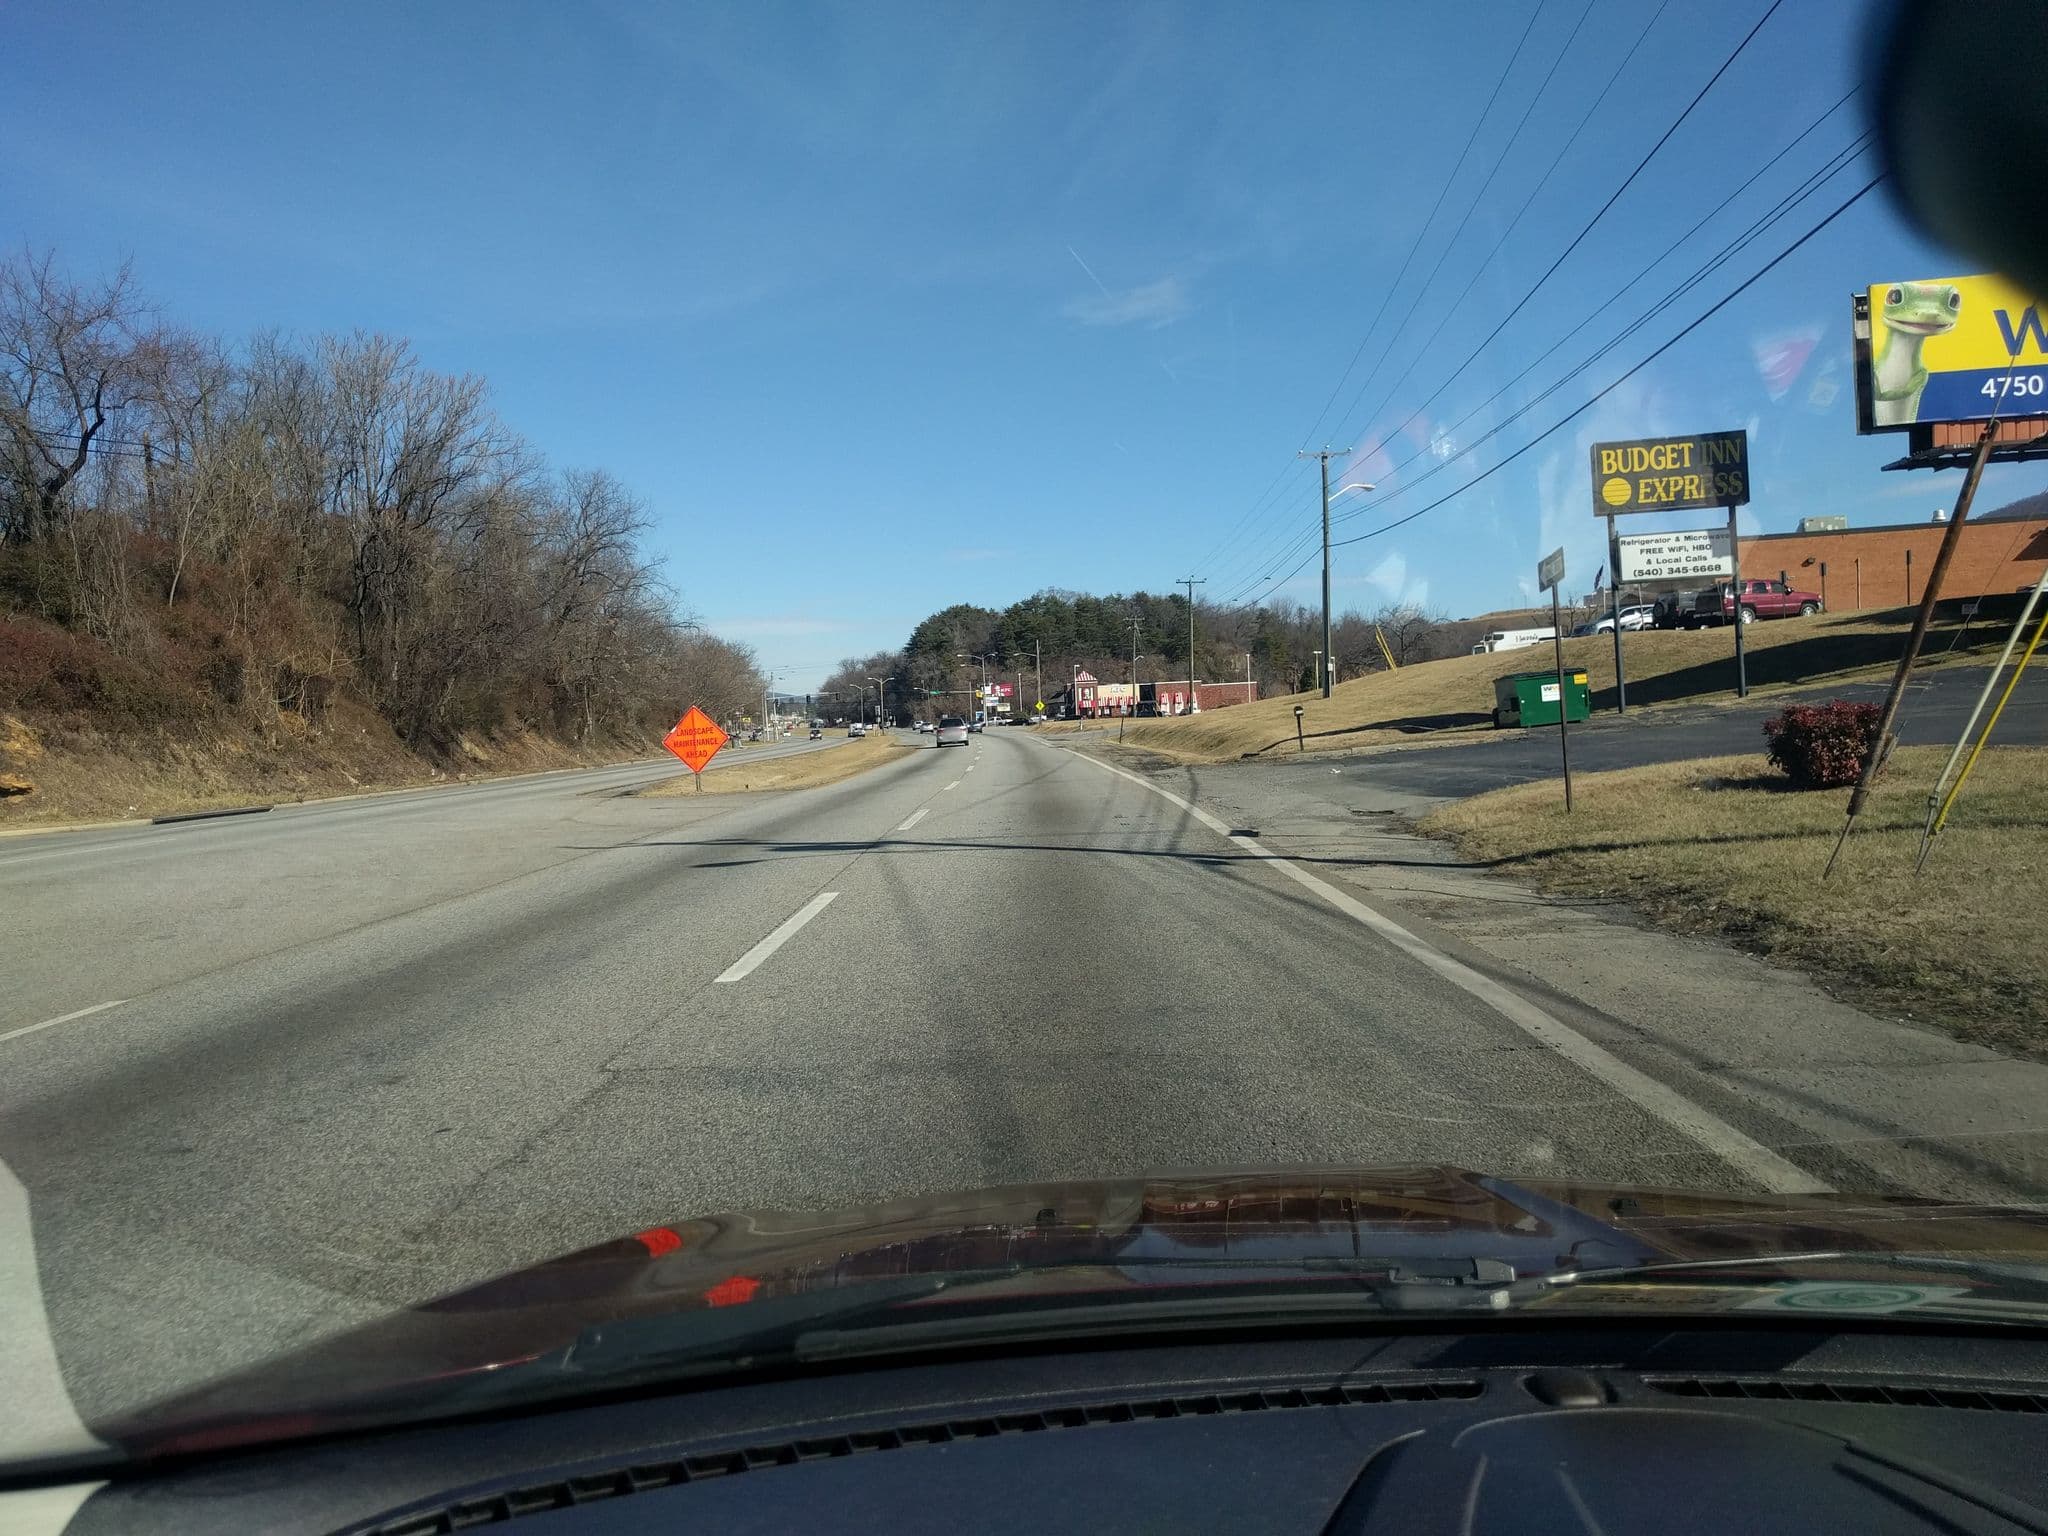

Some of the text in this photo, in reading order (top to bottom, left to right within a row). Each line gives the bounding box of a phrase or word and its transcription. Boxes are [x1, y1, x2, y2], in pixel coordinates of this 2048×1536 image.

[1981, 375, 2043, 398] 4750
[1601, 439, 1741, 475] BUDGET INN
[1638, 472, 1743, 504] EXPRESS
[1620, 537, 1672, 547] Refrigerator
[1684, 533, 1730, 542] Microwave
[1640, 547, 1664, 555] FREE
[1692, 544, 1712, 552] HBO
[1656, 557, 1682, 565] Local
[1685, 555, 1708, 563] Calls
[1633, 564, 1722, 578] (540) 345-6668
[677, 727, 714, 736] LANDSCAPE
[673, 738, 719, 748] MAINTENANCE
[686, 750, 708, 758] AHEAD
